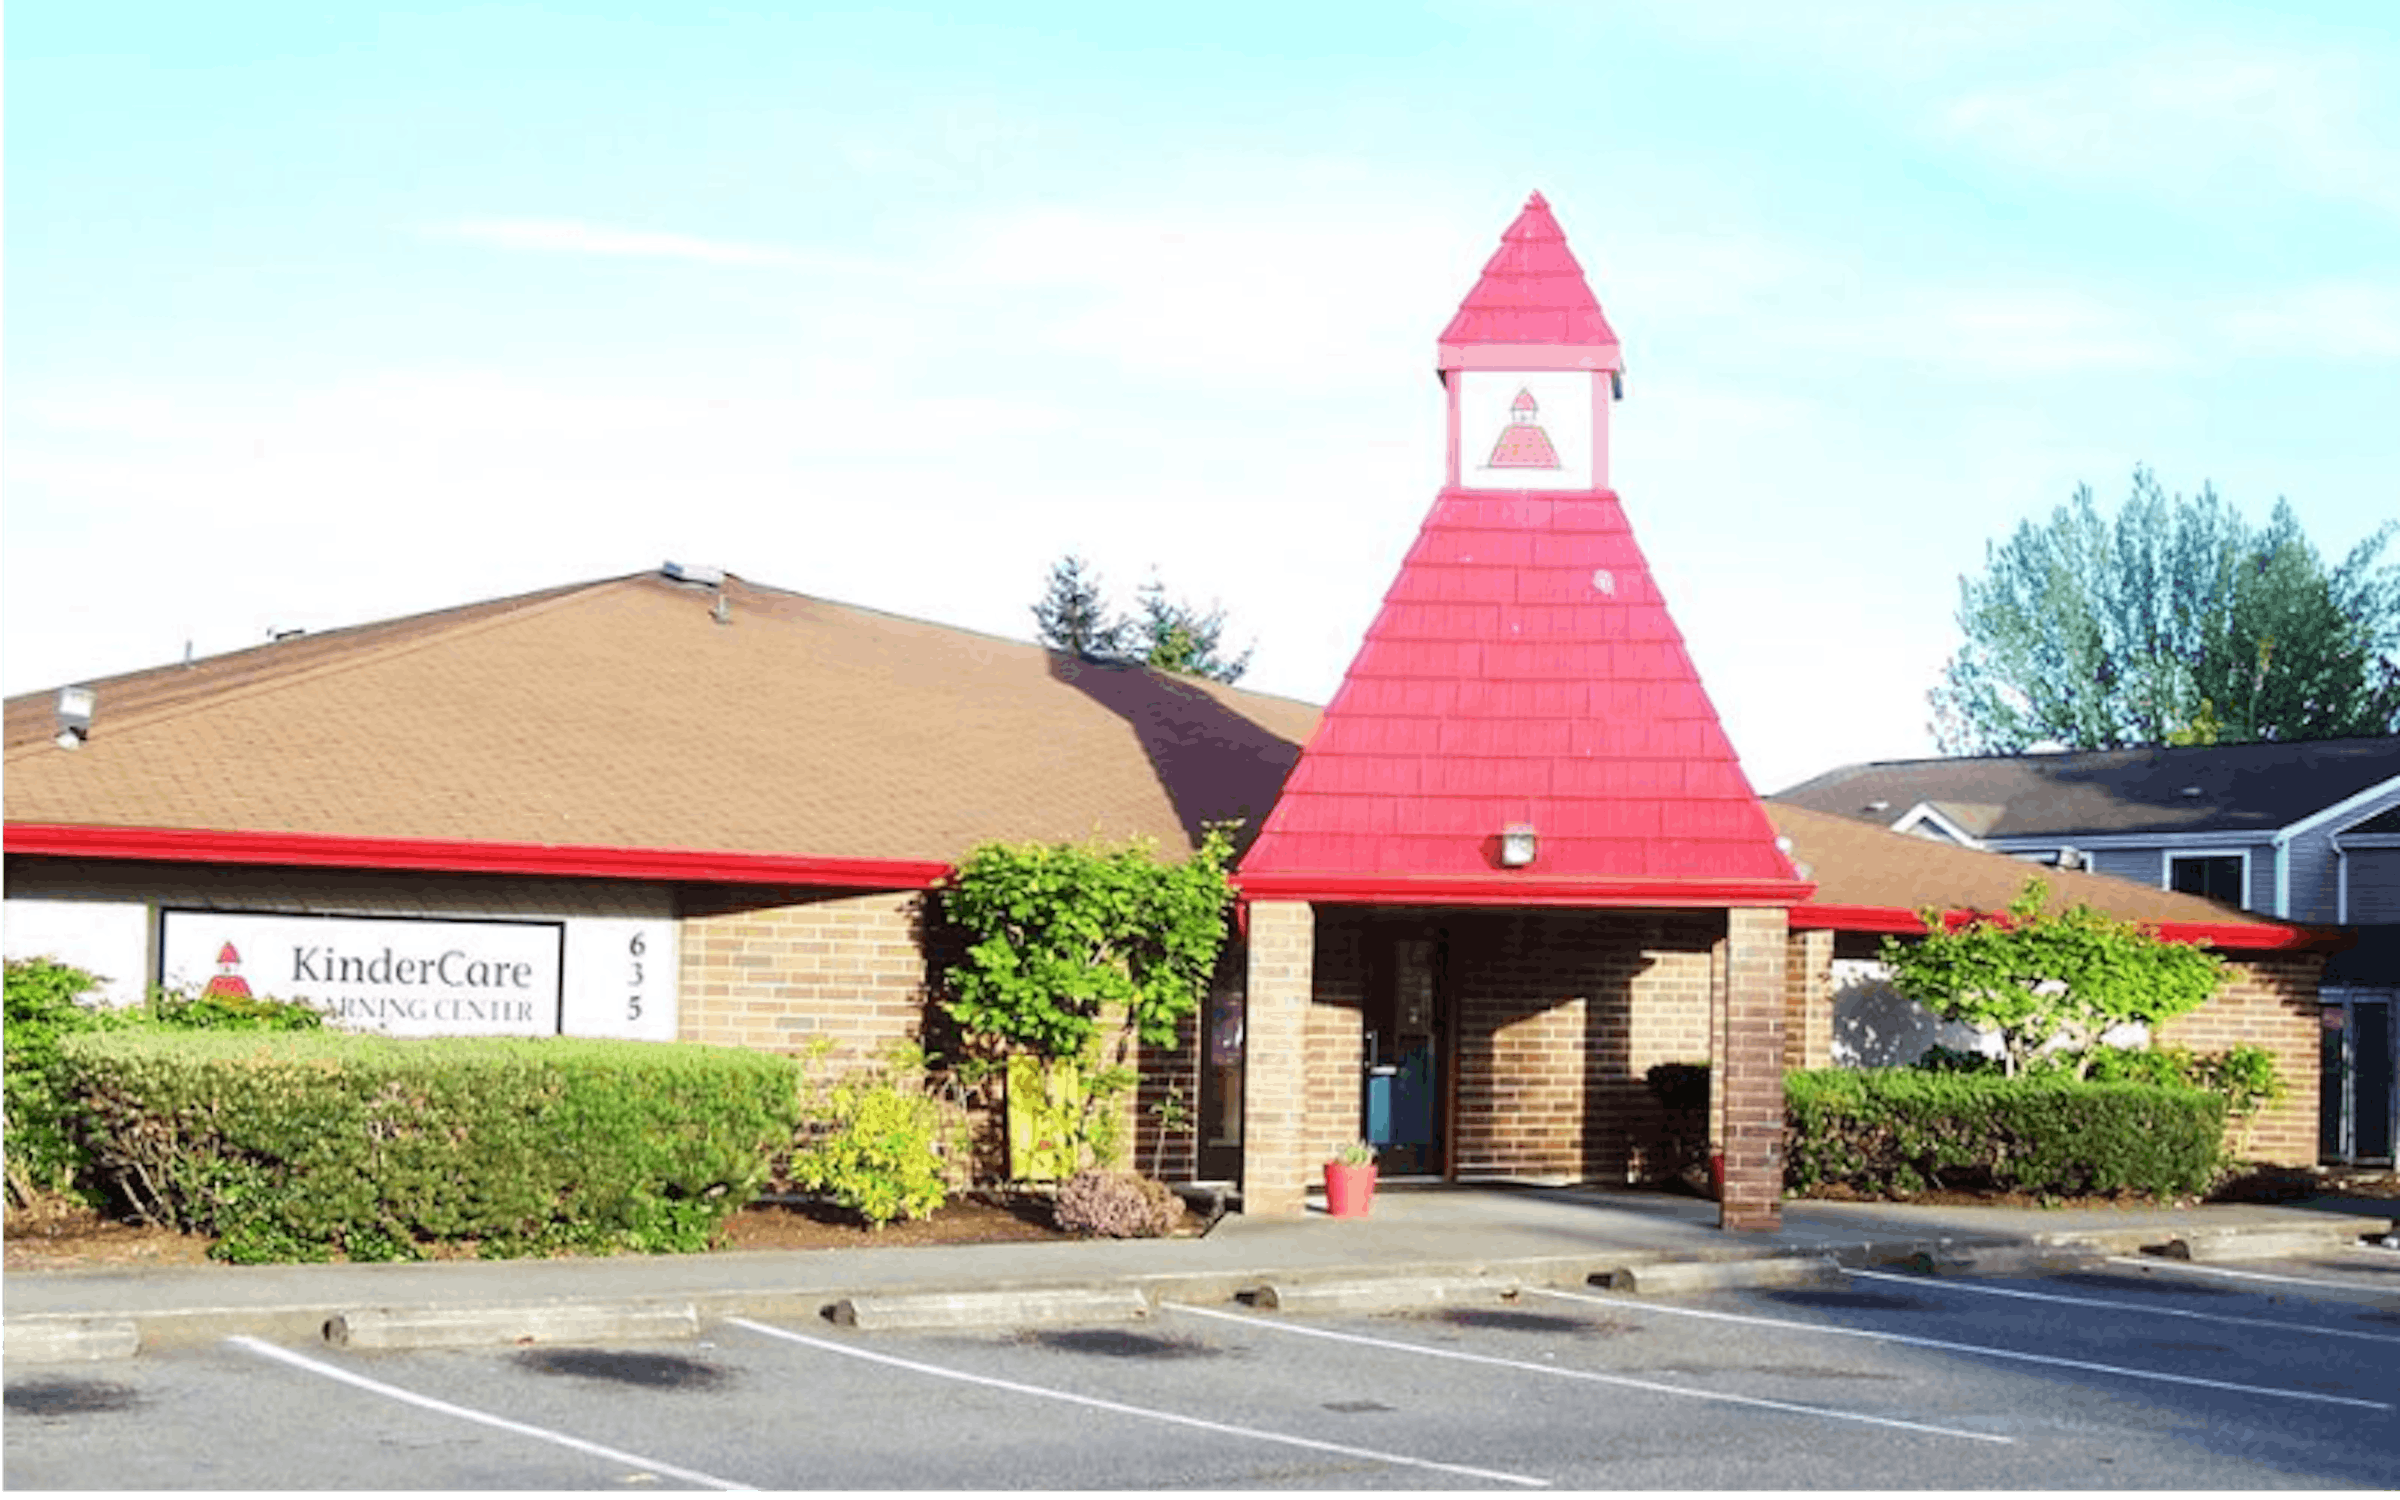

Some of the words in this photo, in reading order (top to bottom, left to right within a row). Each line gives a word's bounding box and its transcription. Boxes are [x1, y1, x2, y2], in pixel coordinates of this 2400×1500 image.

[292, 946, 533, 988] KinderCare
[298, 997, 427, 1018] RNING
[434, 998, 533, 1021] CENTER
